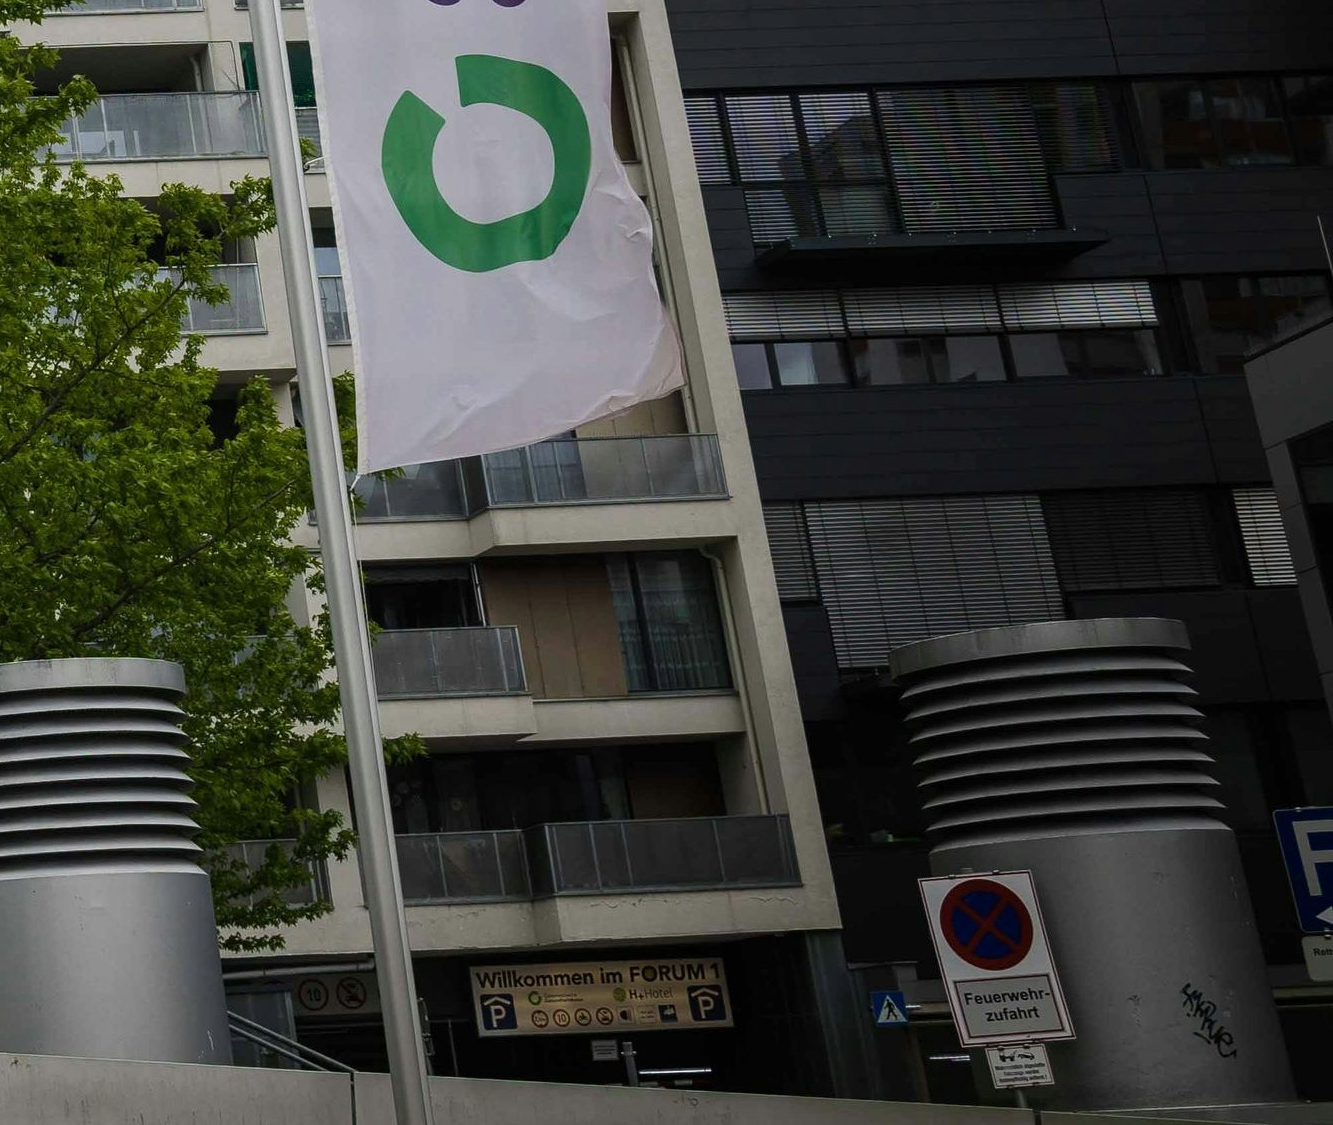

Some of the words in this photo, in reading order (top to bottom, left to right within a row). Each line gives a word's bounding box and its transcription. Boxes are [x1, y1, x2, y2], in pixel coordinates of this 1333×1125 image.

[475, 969, 595, 989] Willkommen
[599, 967, 623, 985] im
[629, 963, 706, 983] FORUM
[710, 962, 721, 979] 1
[308, 987, 322, 1002] 10
[629, 987, 674, 1001] H+Hotel
[963, 987, 1051, 1006] Feuerwehr-
[557, 1011, 568, 1024] 10
[985, 1006, 1041, 1022] zufahrt
